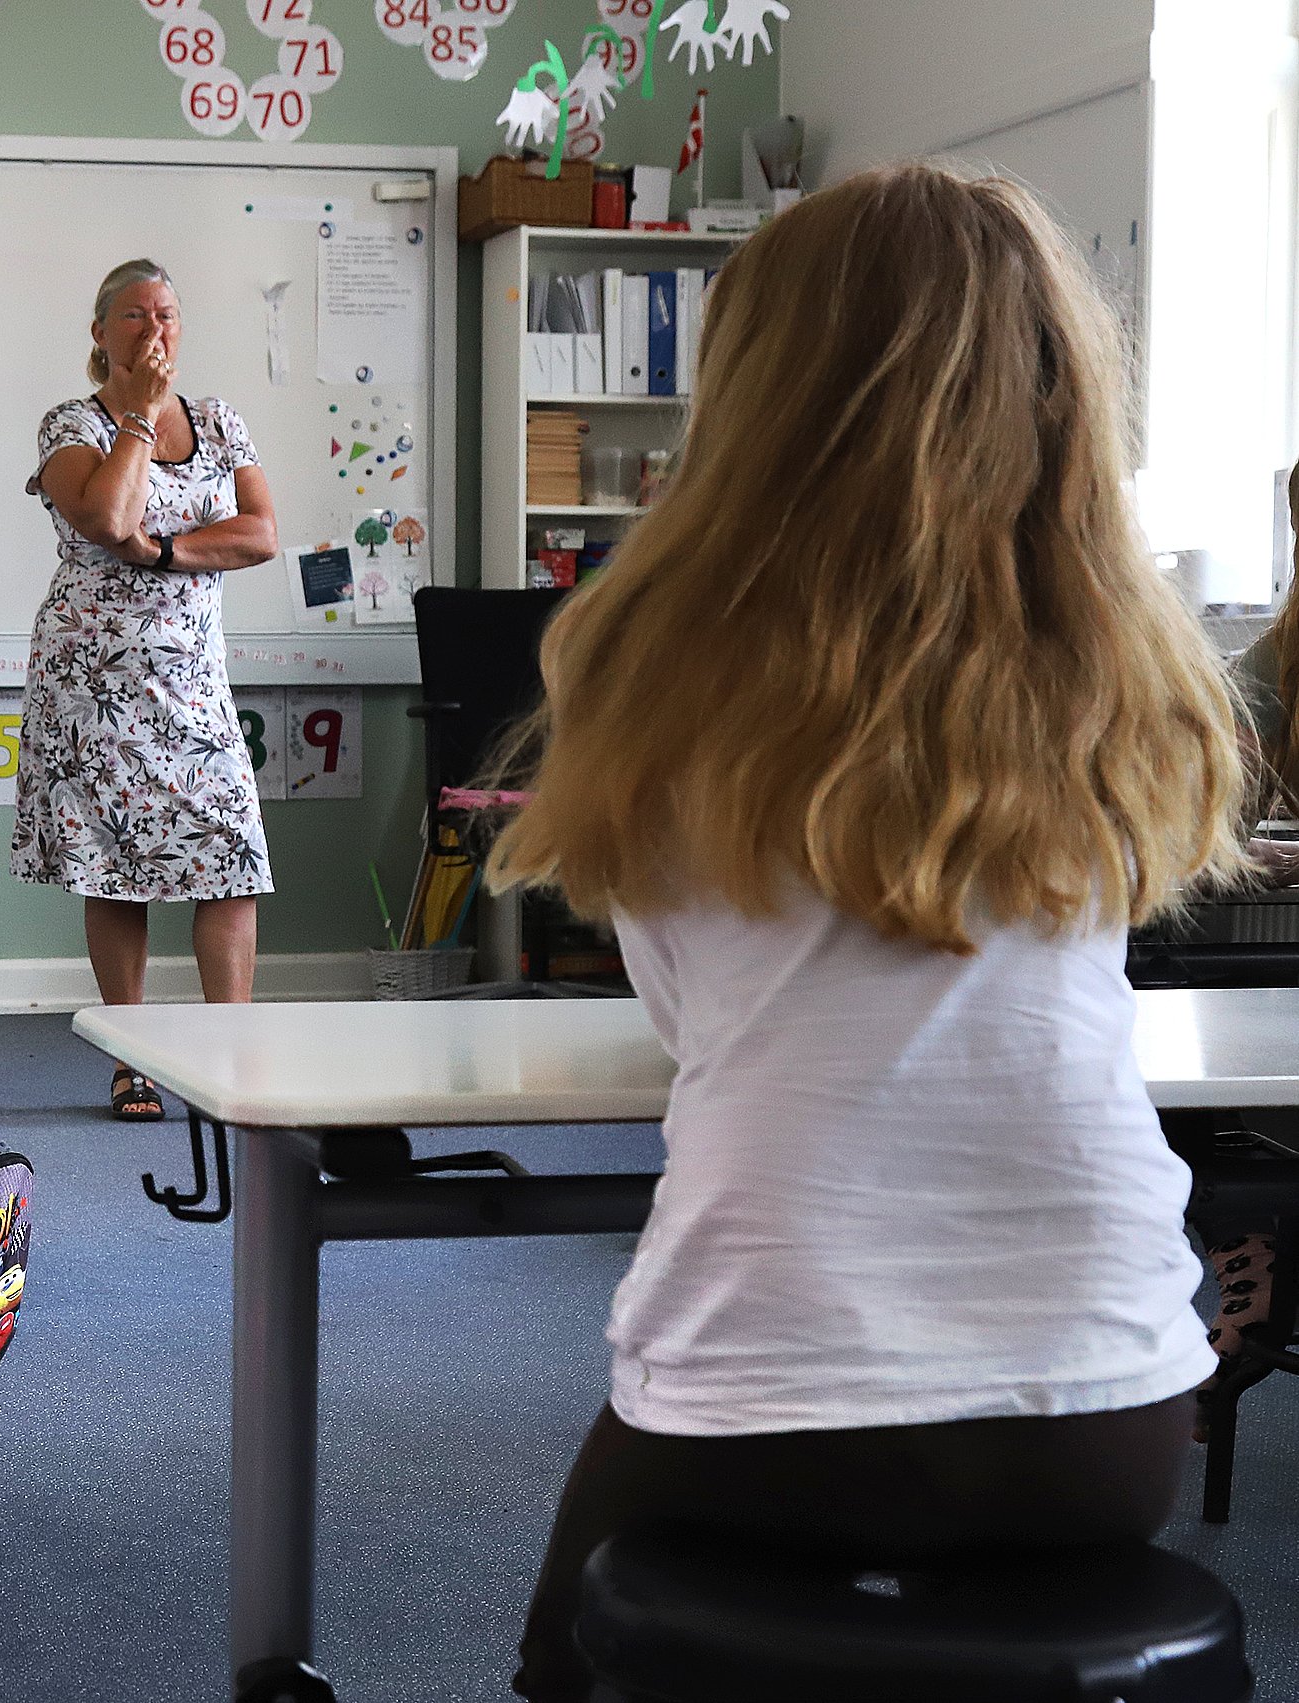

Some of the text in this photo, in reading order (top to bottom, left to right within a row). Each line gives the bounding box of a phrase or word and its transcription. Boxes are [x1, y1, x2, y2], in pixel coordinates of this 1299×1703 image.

[384, 0, 432, 28] 84
[166, 26, 214, 66] 68
[286, 38, 337, 77] 71
[432, 25, 478, 63] 85
[190, 82, 239, 120] 69
[253, 90, 304, 129] 70
[303, 708, 343, 773] 9
